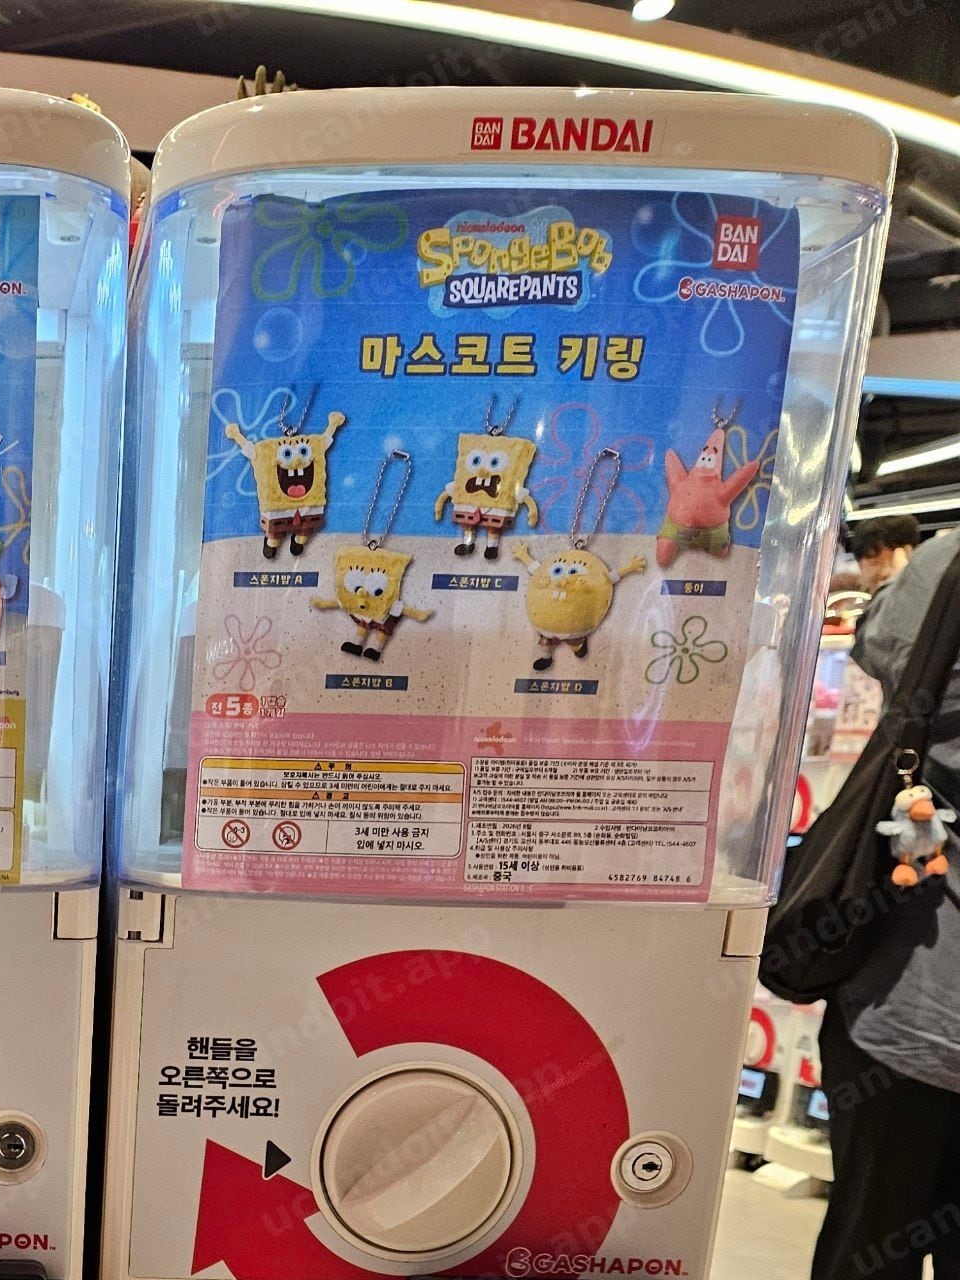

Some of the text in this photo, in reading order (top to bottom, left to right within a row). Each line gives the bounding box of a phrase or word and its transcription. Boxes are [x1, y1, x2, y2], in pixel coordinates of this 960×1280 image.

[475, 122, 499, 134] BAN
[474, 134, 495, 145] DAI
[511, 118, 654, 152] BANDAI
[719, 223, 758, 244] BAN
[718, 243, 748, 263] DAI
[449, 274, 578, 304] SQUAREPANTS
[360, 333, 645, 382] 마스코트 키링
[250, 575, 303, 585] 스폰지밥 A
[448, 577, 502, 588] 스폰지밥 C
[342, 678, 393, 688] 스폰지밥 B
[530, 681, 570, 692] 스폰지밥
[355, 827, 429, 838] 3세 미만 사용 금지
[356, 840, 374, 851] 입에
[376, 840, 394, 851] 넣지
[498, 861, 539, 872] 15세 이상
[493, 871, 512, 881] 중국
[608, 874, 647, 882] 4582769
[186, 1037, 258, 1062] 핸들을
[159, 1066, 277, 1090] 오른쪽으로
[157, 1094, 279, 1119] 돌려주세요!
